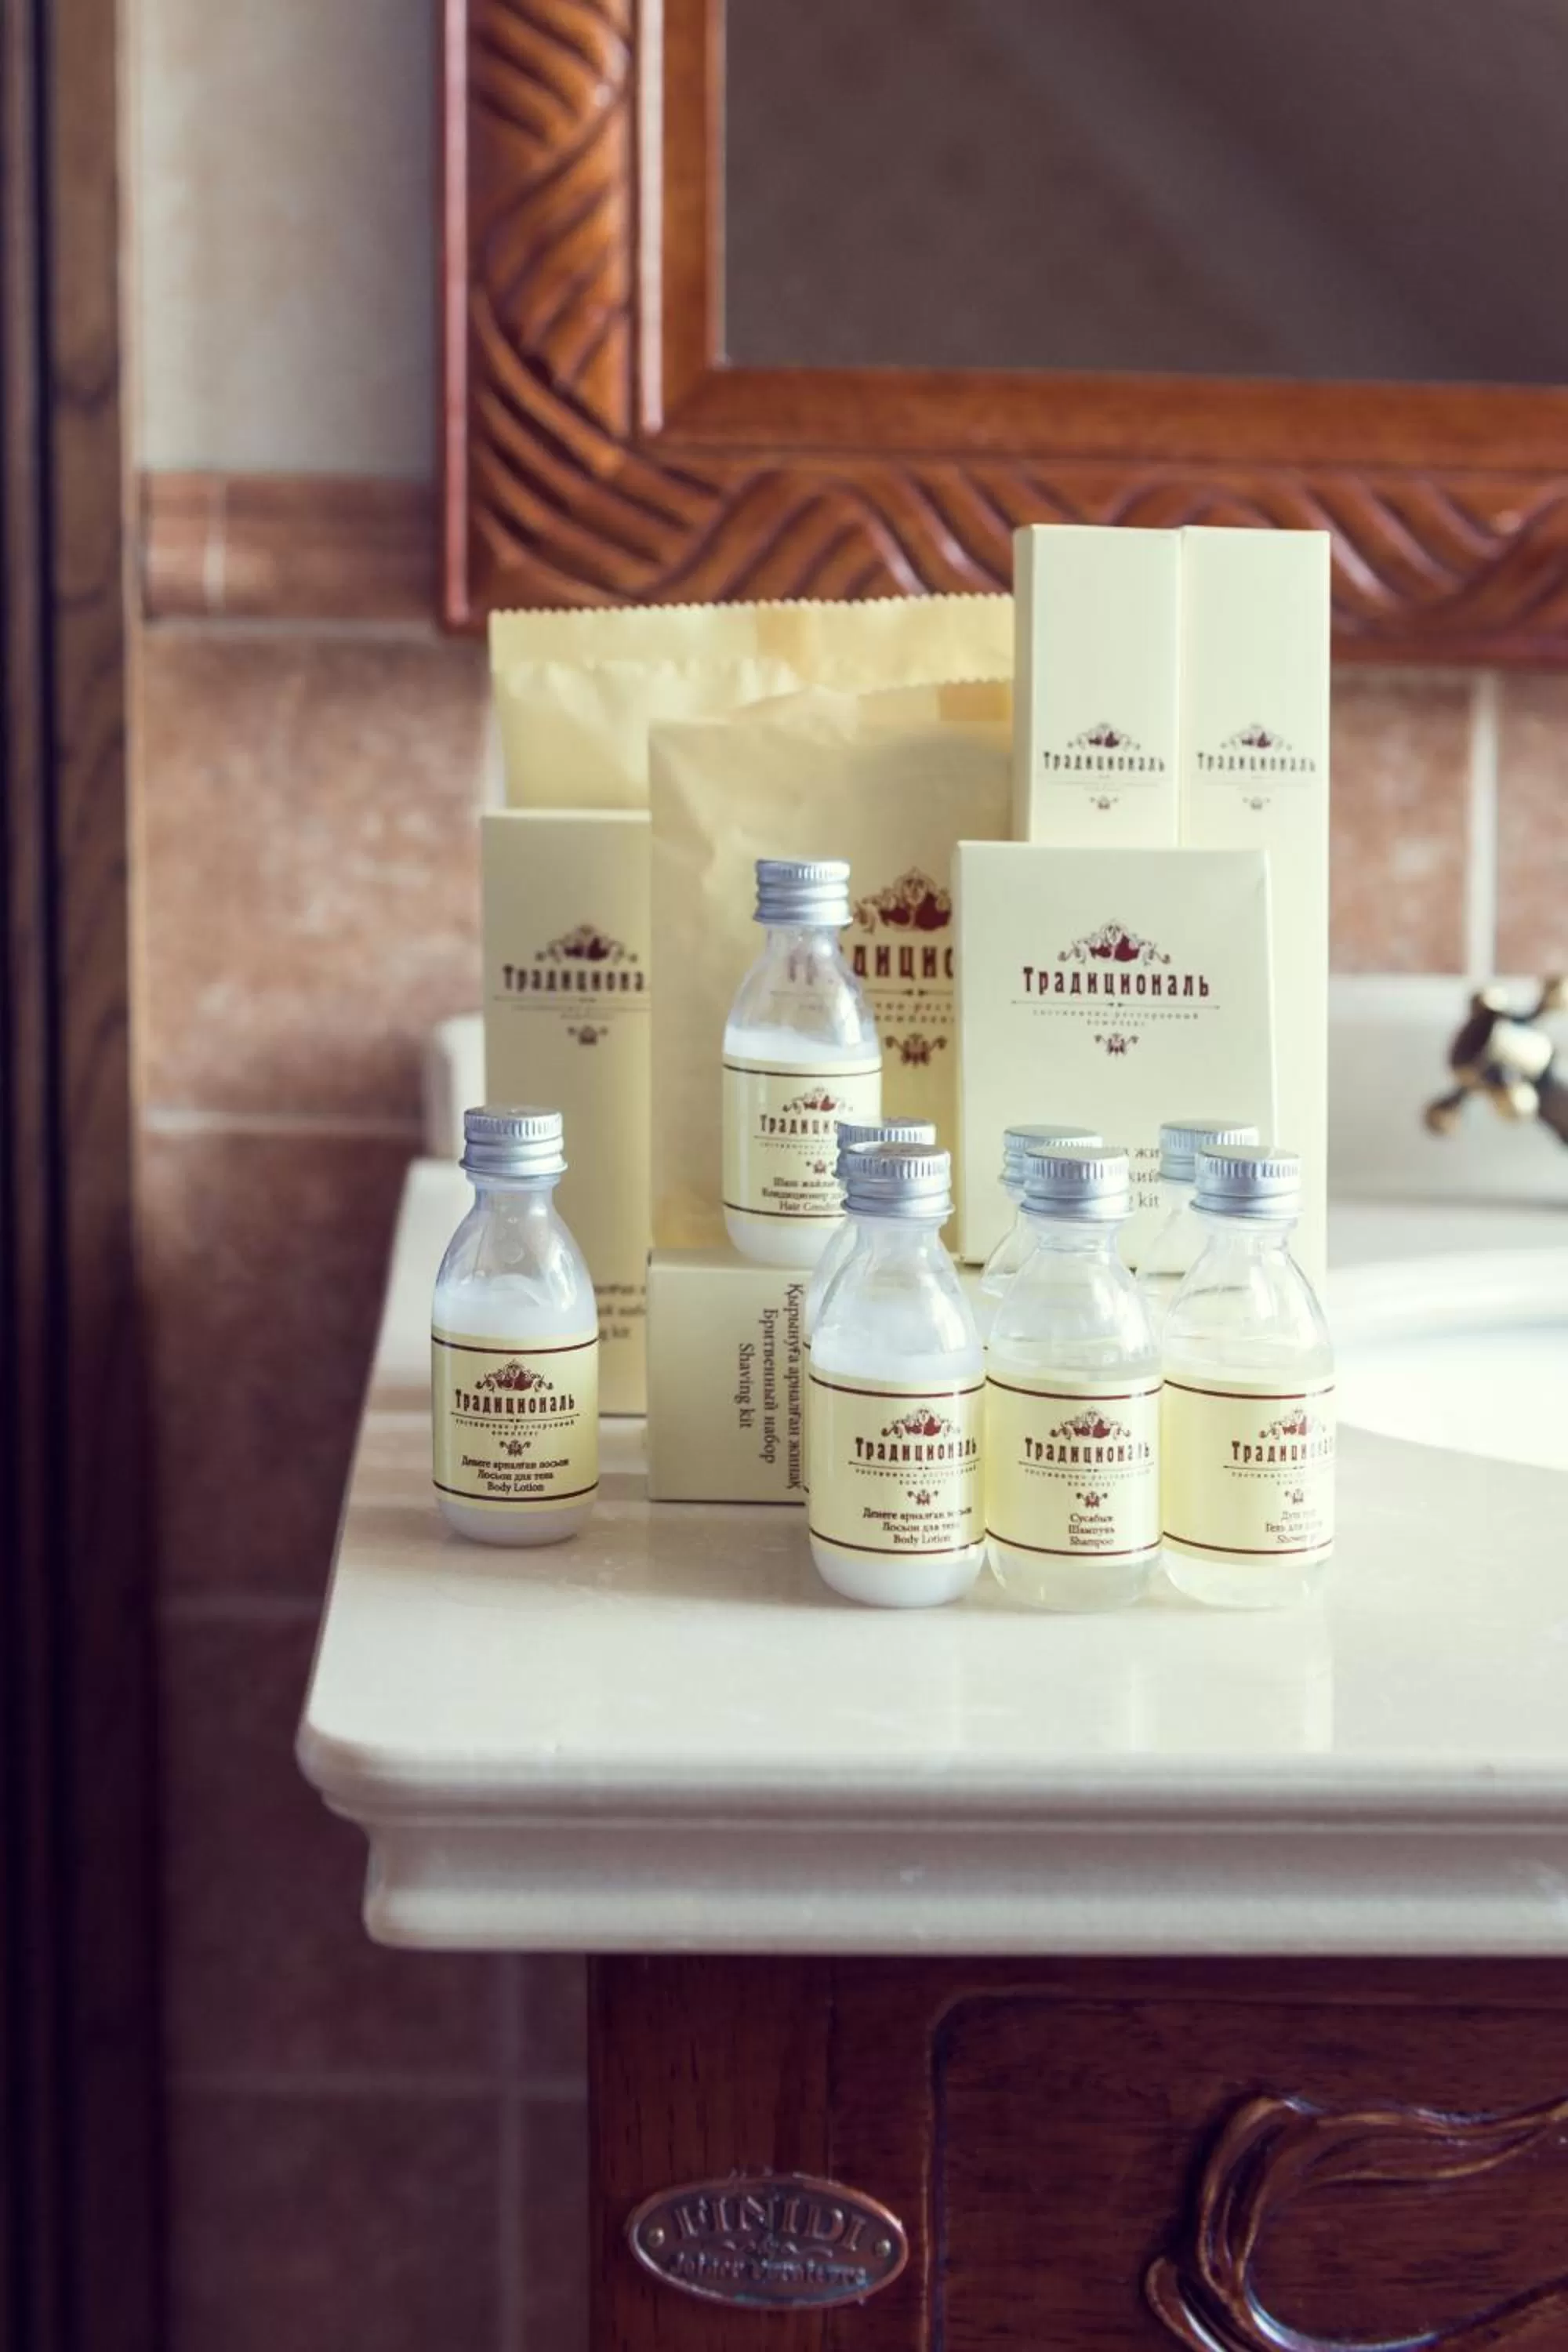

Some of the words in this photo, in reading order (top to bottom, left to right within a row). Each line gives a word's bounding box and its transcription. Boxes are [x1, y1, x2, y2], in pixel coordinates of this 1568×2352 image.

[503, 964, 644, 993] Традициона
[1022, 966, 1210, 998] Традициональ
[1138, 1191, 1160, 1208] kit
[758, 1308, 779, 1411] Бритвенный
[734, 1342, 756, 1405] Shaving
[455, 1388, 575, 1414] Традициональ
[739, 1408, 757, 1429] kit
[758, 1416, 781, 1465] набор
[855, 1437, 977, 1462] Традициональ
[488, 1481, 512, 1495] Body
[514, 1481, 546, 1493] Lotion
[893, 1534, 919, 1546] Body
